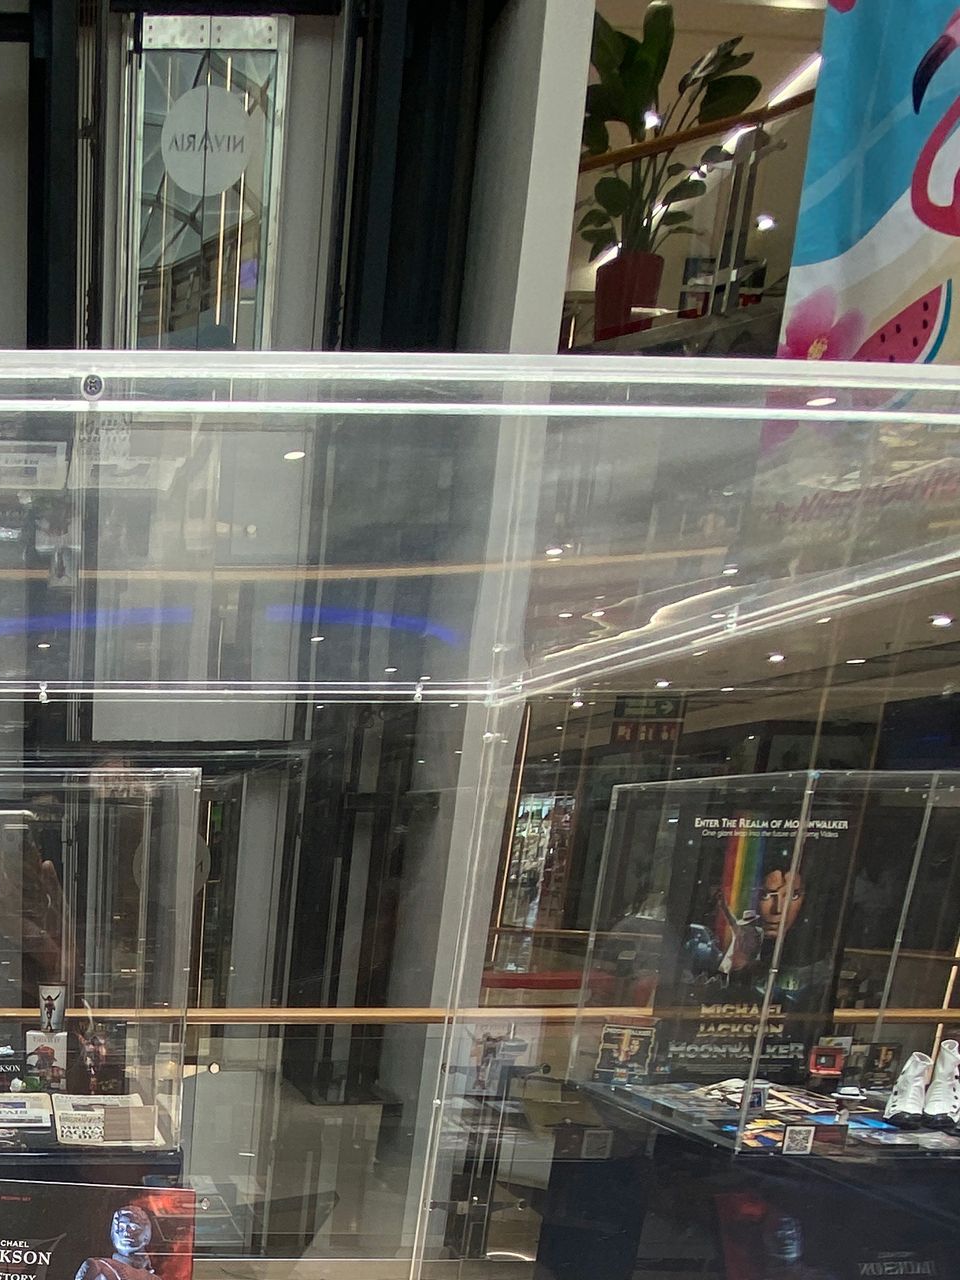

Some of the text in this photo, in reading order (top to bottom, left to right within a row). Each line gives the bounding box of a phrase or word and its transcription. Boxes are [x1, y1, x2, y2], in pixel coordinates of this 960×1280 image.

[695, 818, 719, 828] ENTER
[722, 818, 736, 828] THE
[739, 818, 768, 828] REALM
[770, 820, 781, 829] OF
